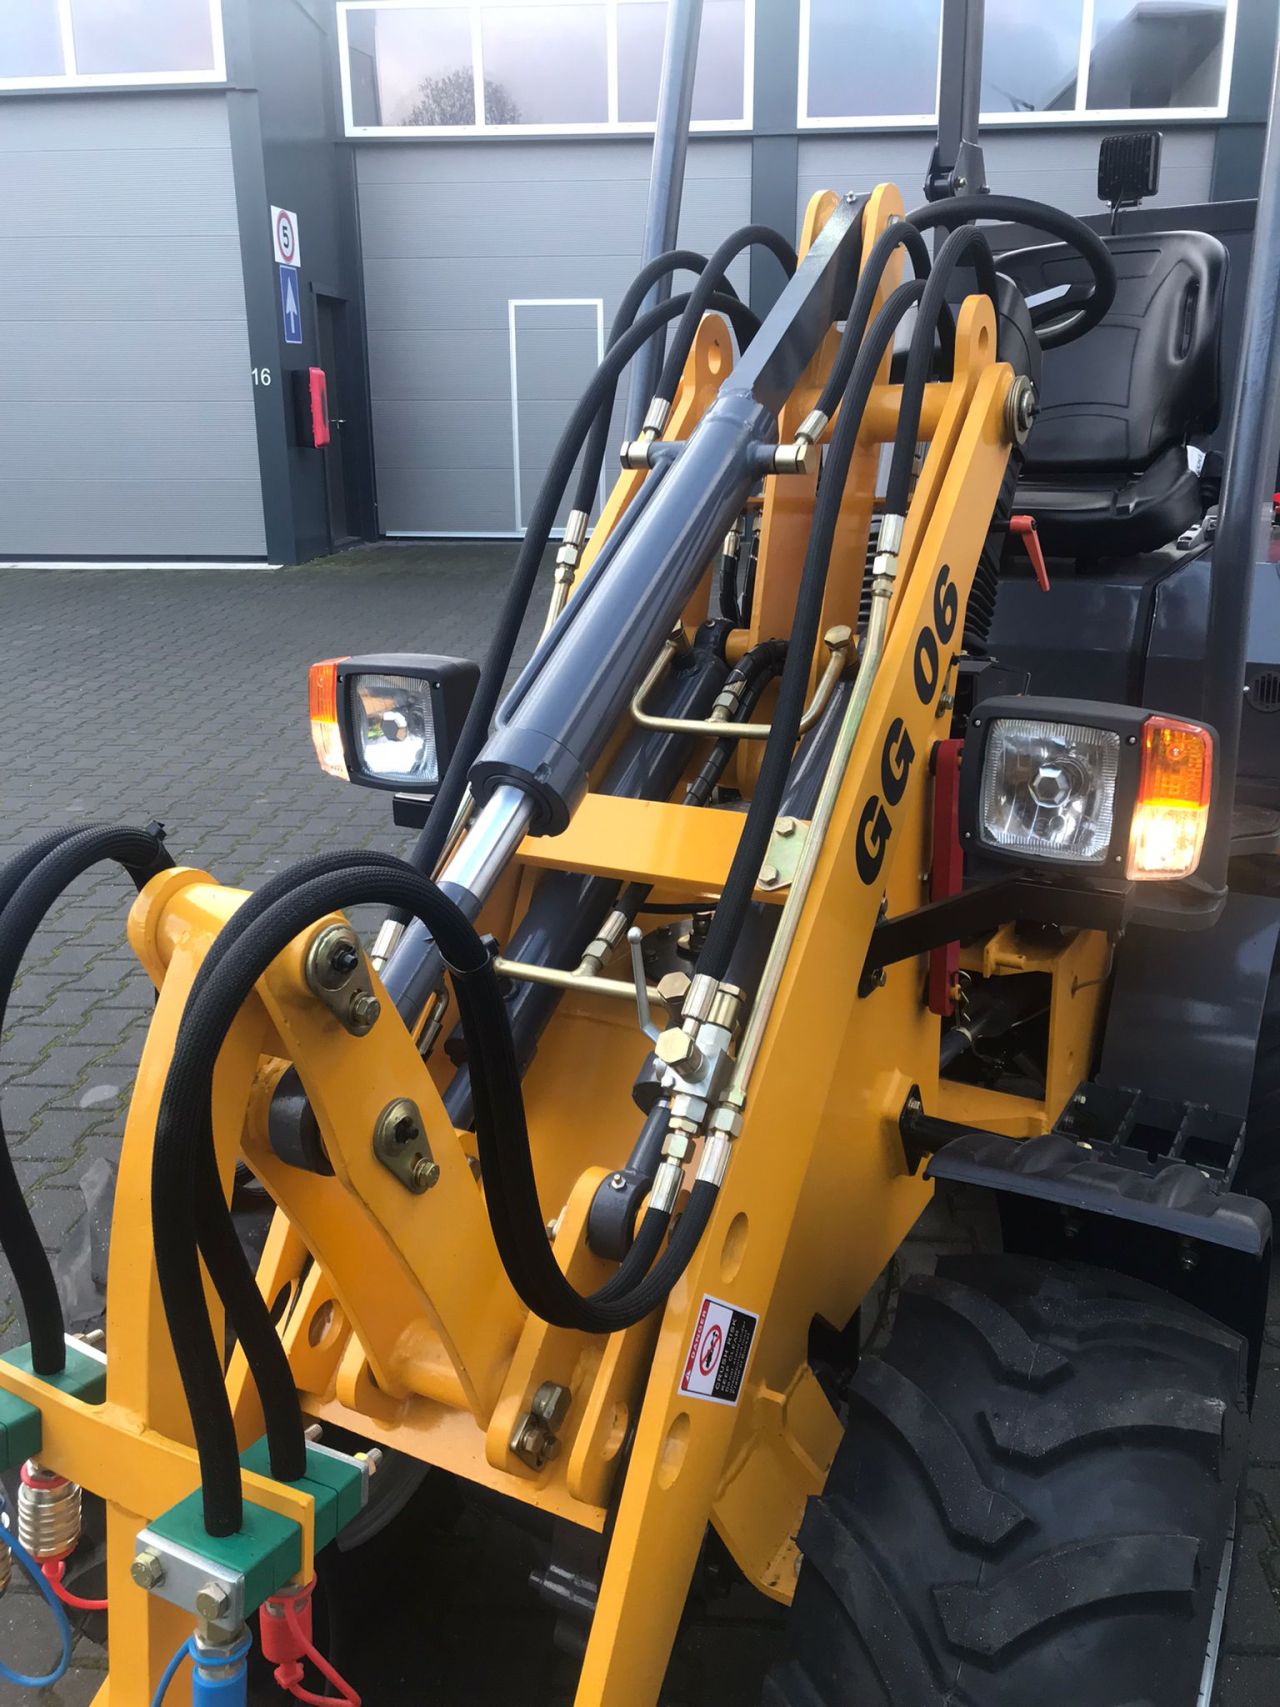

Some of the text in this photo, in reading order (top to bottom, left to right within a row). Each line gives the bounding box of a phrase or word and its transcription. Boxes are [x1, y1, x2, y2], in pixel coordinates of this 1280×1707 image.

[282, 226, 289, 248] 5
[251, 367, 272, 387] 16
[855, 716, 916, 886] GG
[691, 1309, 706, 1359] DANGER
[715, 1319, 737, 1390] CRUSH RISK
[721, 1330, 739, 1391] KEEP CLEAR
